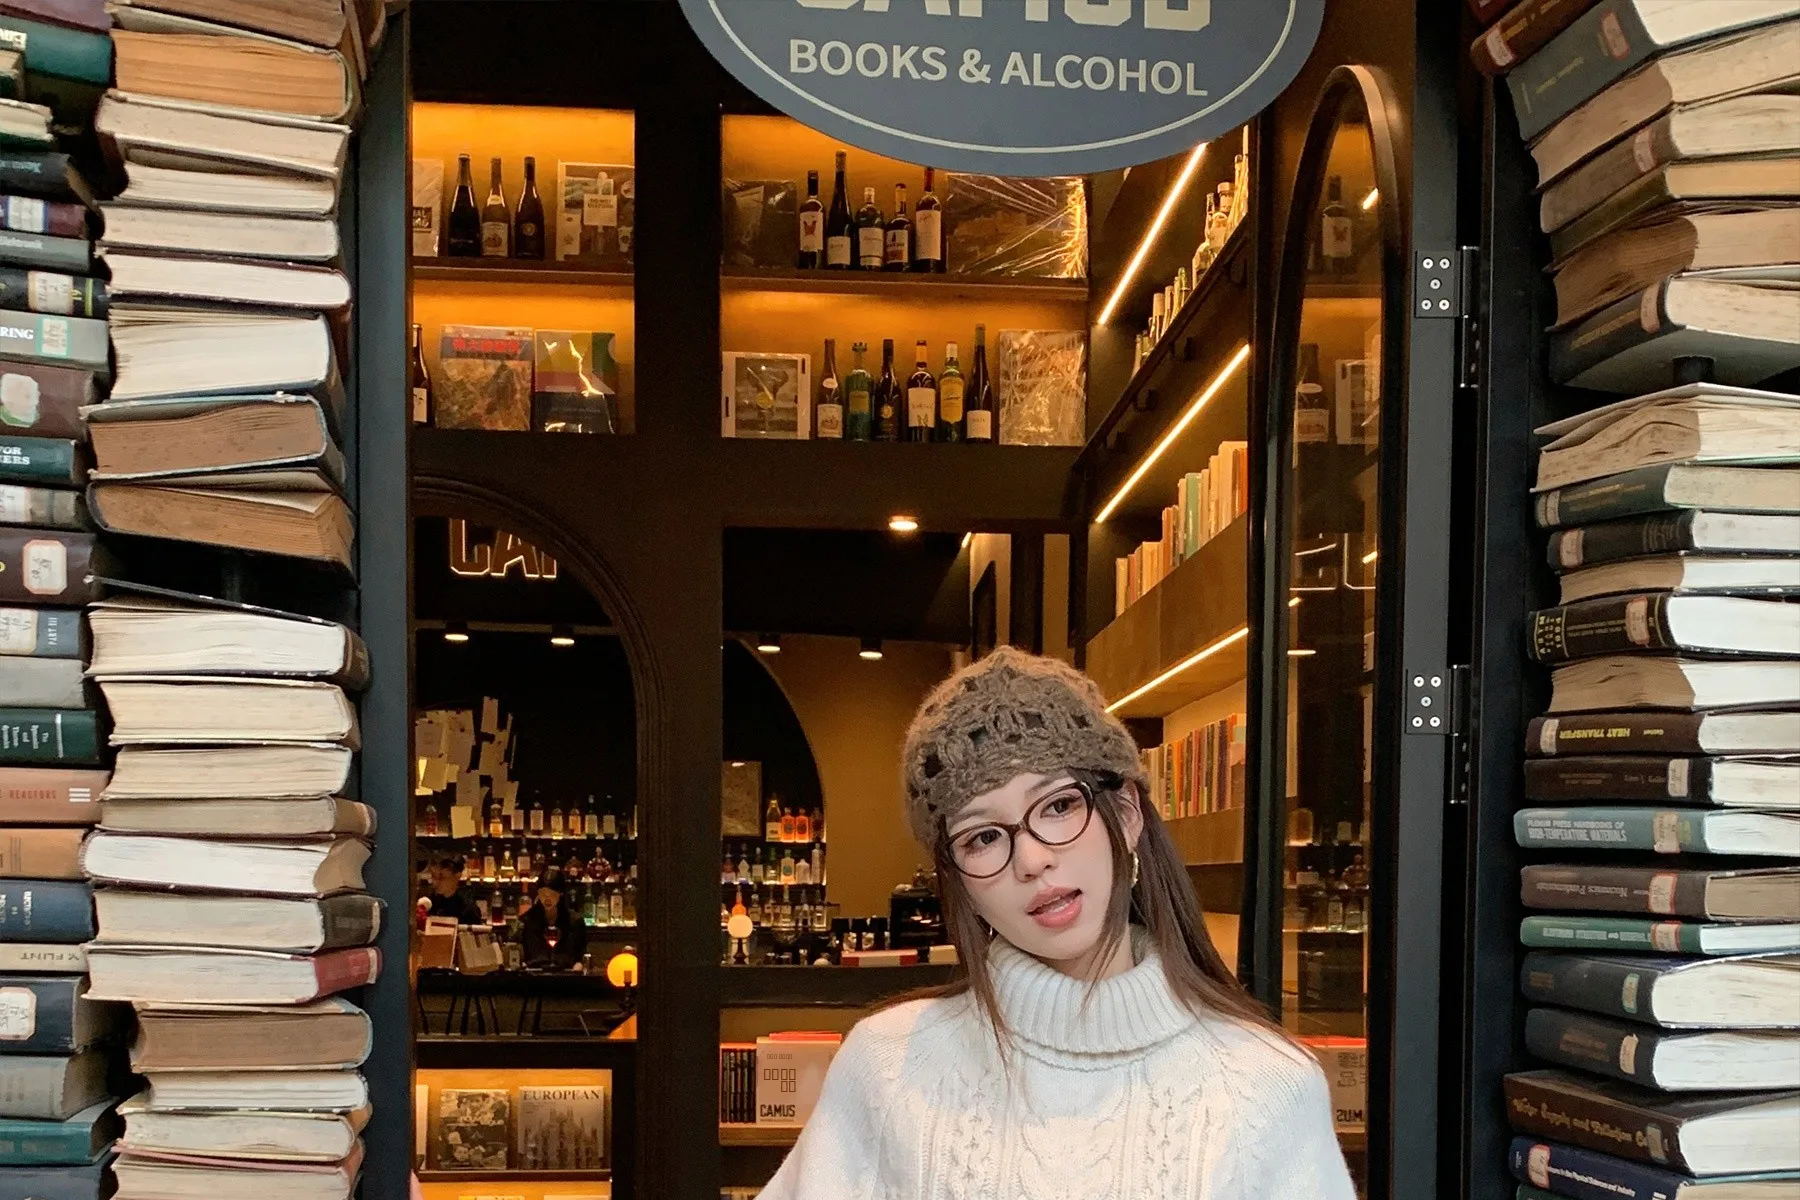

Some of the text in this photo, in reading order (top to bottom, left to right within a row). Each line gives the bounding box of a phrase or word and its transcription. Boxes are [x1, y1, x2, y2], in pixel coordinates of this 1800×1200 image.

[789, 37, 1209, 98] BOOKS & ALCOHOL
[47, 628, 58, 645] PART
[1559, 728, 1605, 739] TRANSFER
[1606, 728, 1631, 738] HEAT
[9, 789, 57, 800] REACTORS
[20, 952, 64, 961] FLINT
[523, 1089, 601, 1101] EUROPEAN
[760, 1104, 795, 1118] CAMUS
[1572, 1117, 1590, 1132] and
